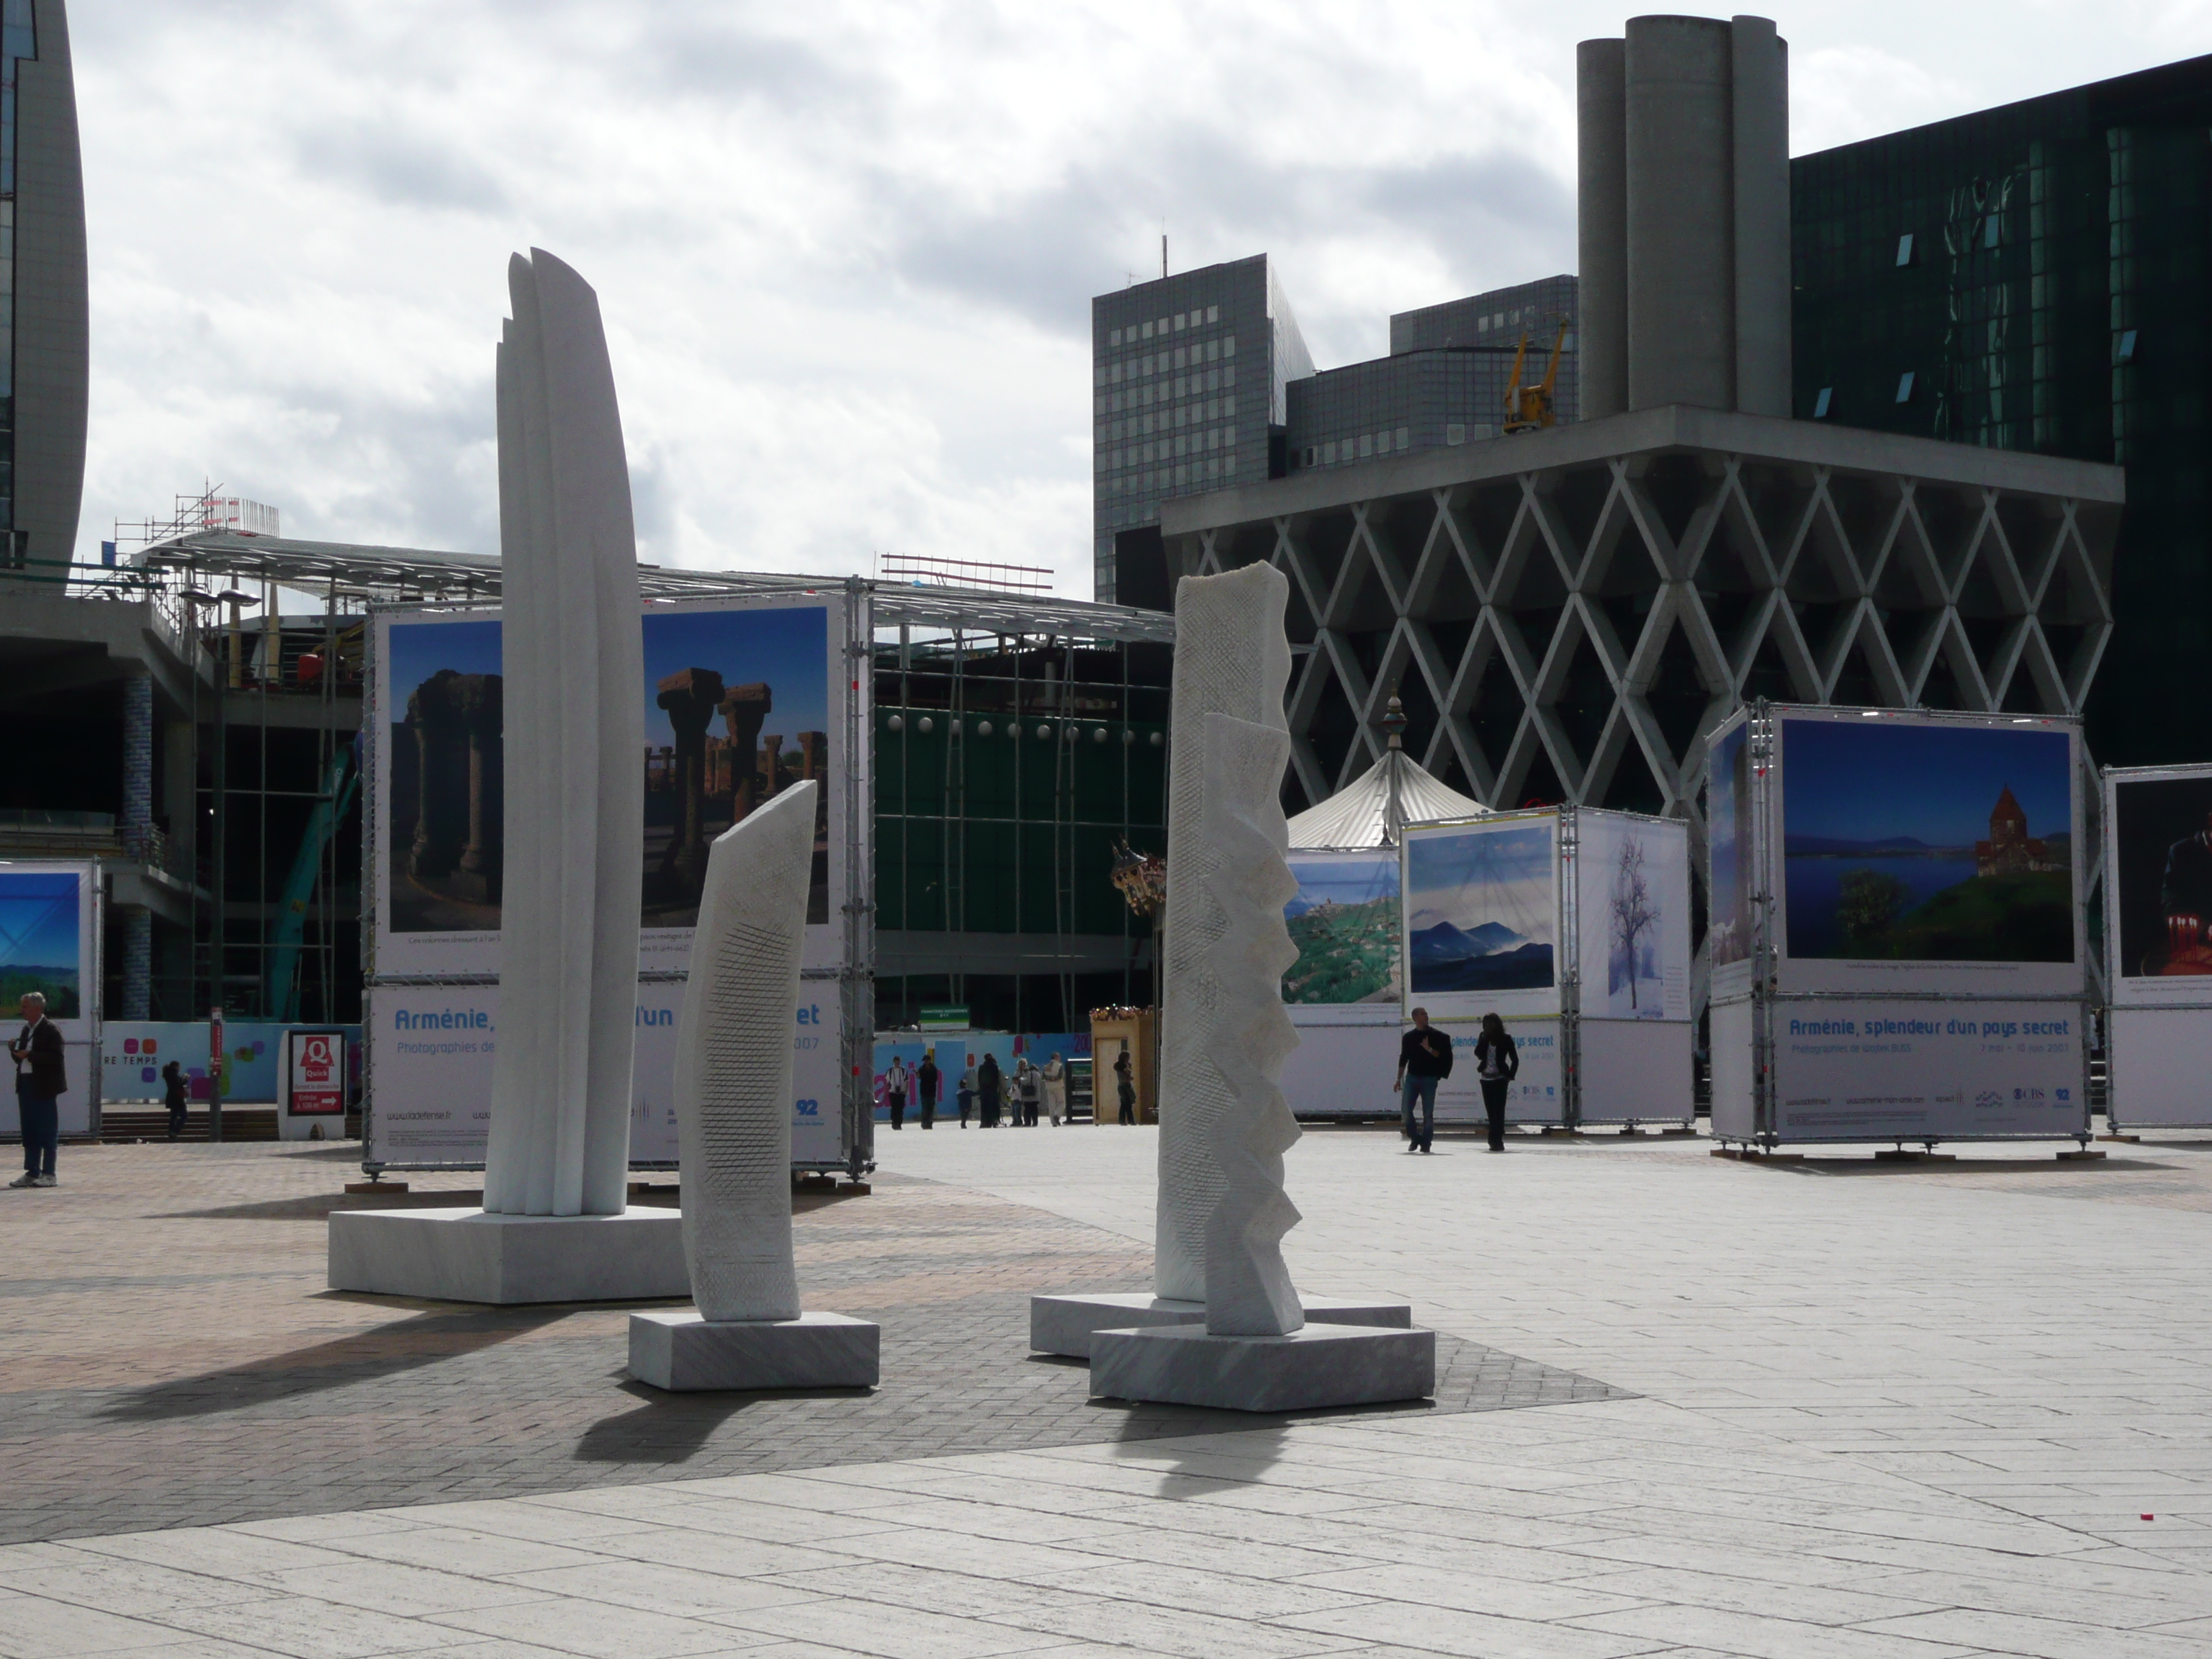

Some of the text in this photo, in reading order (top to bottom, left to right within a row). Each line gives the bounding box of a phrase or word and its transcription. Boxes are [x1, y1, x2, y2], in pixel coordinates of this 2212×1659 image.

[395, 1008, 495, 1032] Arménie,
[1790, 1019, 2069, 1038] Arménie, splendeur d'un pays secret
[1527, 1035, 1553, 1046] secret
[308, 1040, 328, 1064] Q
[397, 1041, 477, 1055] Photographies
[481, 1041, 495, 1052] de
[123, 1056, 157, 1065] TEMPS
[2023, 1088, 2045, 1100] CBS
[2055, 1088, 2070, 1101] 92
[796, 1099, 818, 1115] 92
[387, 1111, 452, 1120] www.ladefense.fr
